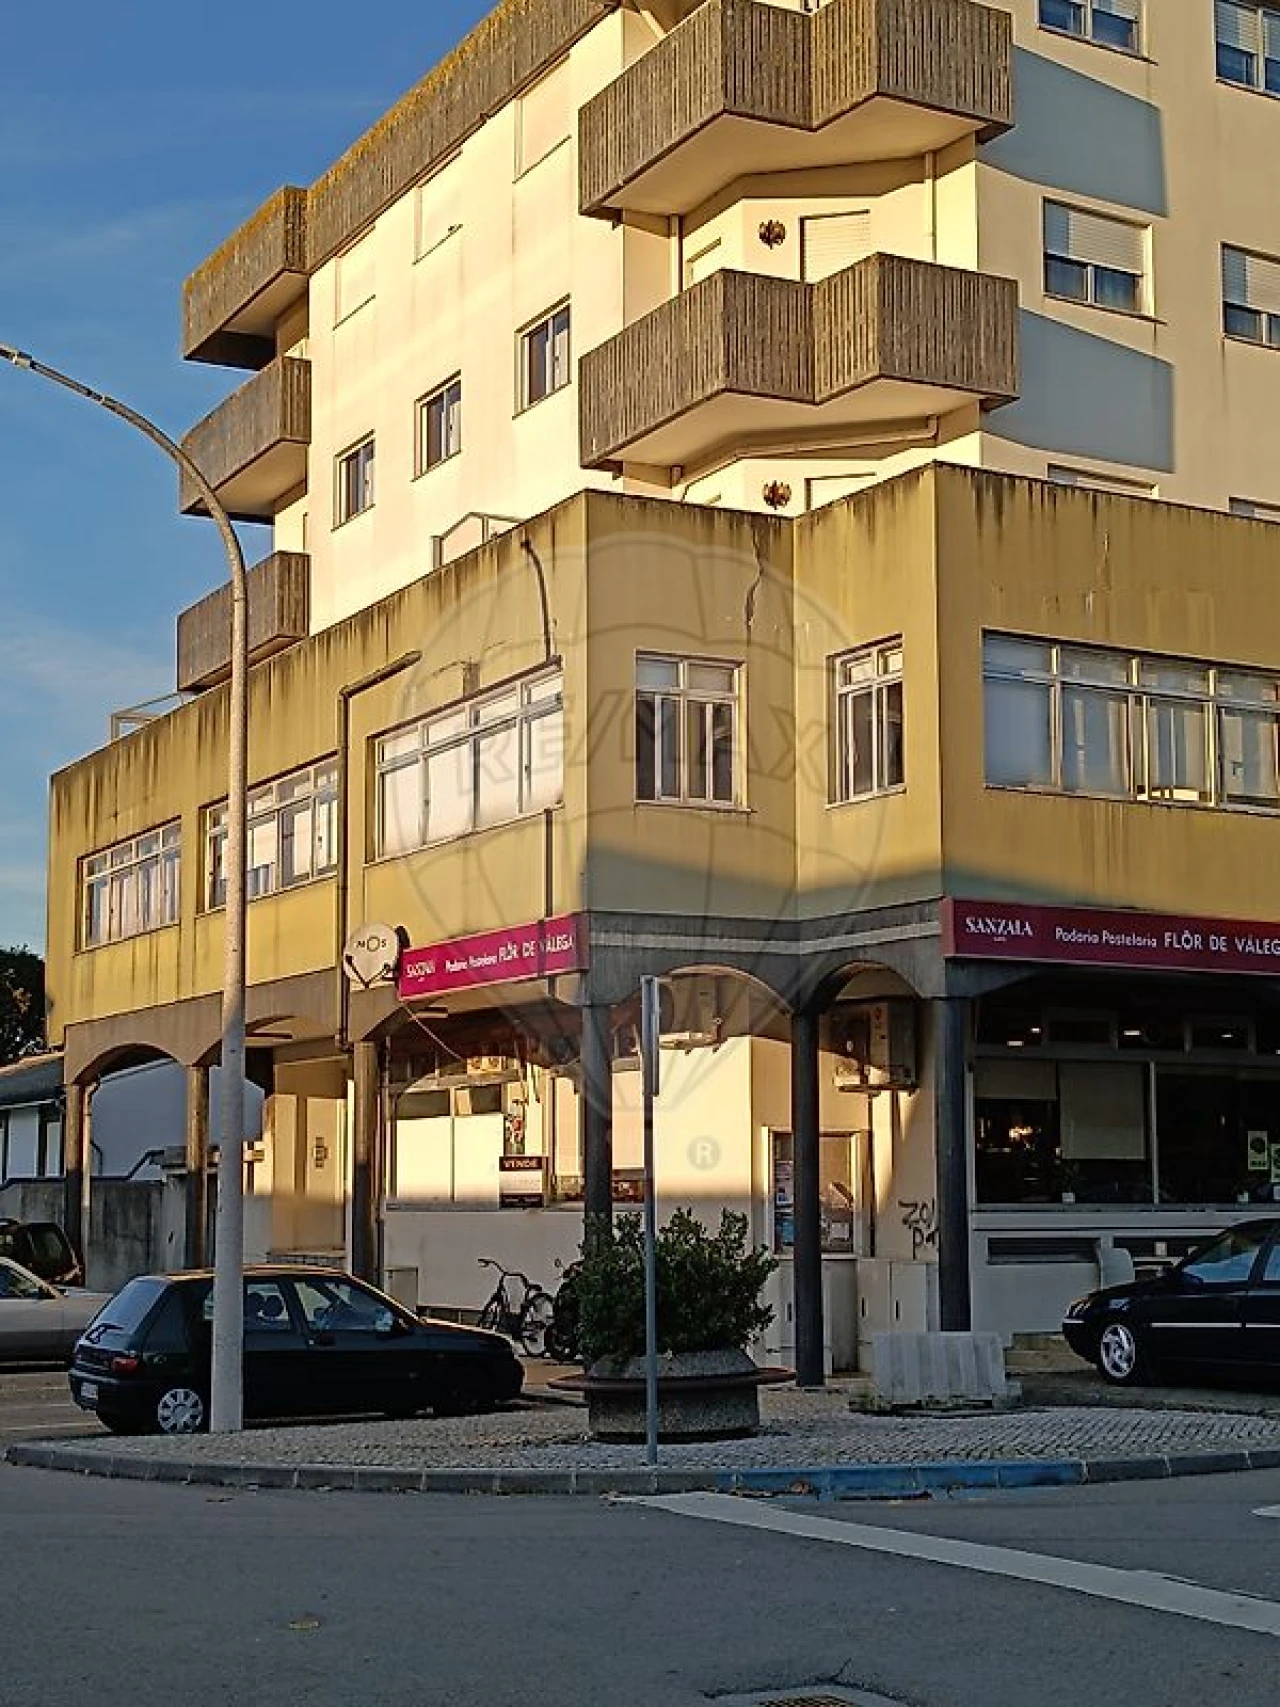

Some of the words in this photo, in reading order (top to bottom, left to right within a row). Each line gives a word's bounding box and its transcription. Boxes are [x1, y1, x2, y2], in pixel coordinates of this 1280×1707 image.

[966, 917, 1033, 936] SANZALA
[522, 940, 536, 958] DE
[1209, 934, 1228, 952] DE
